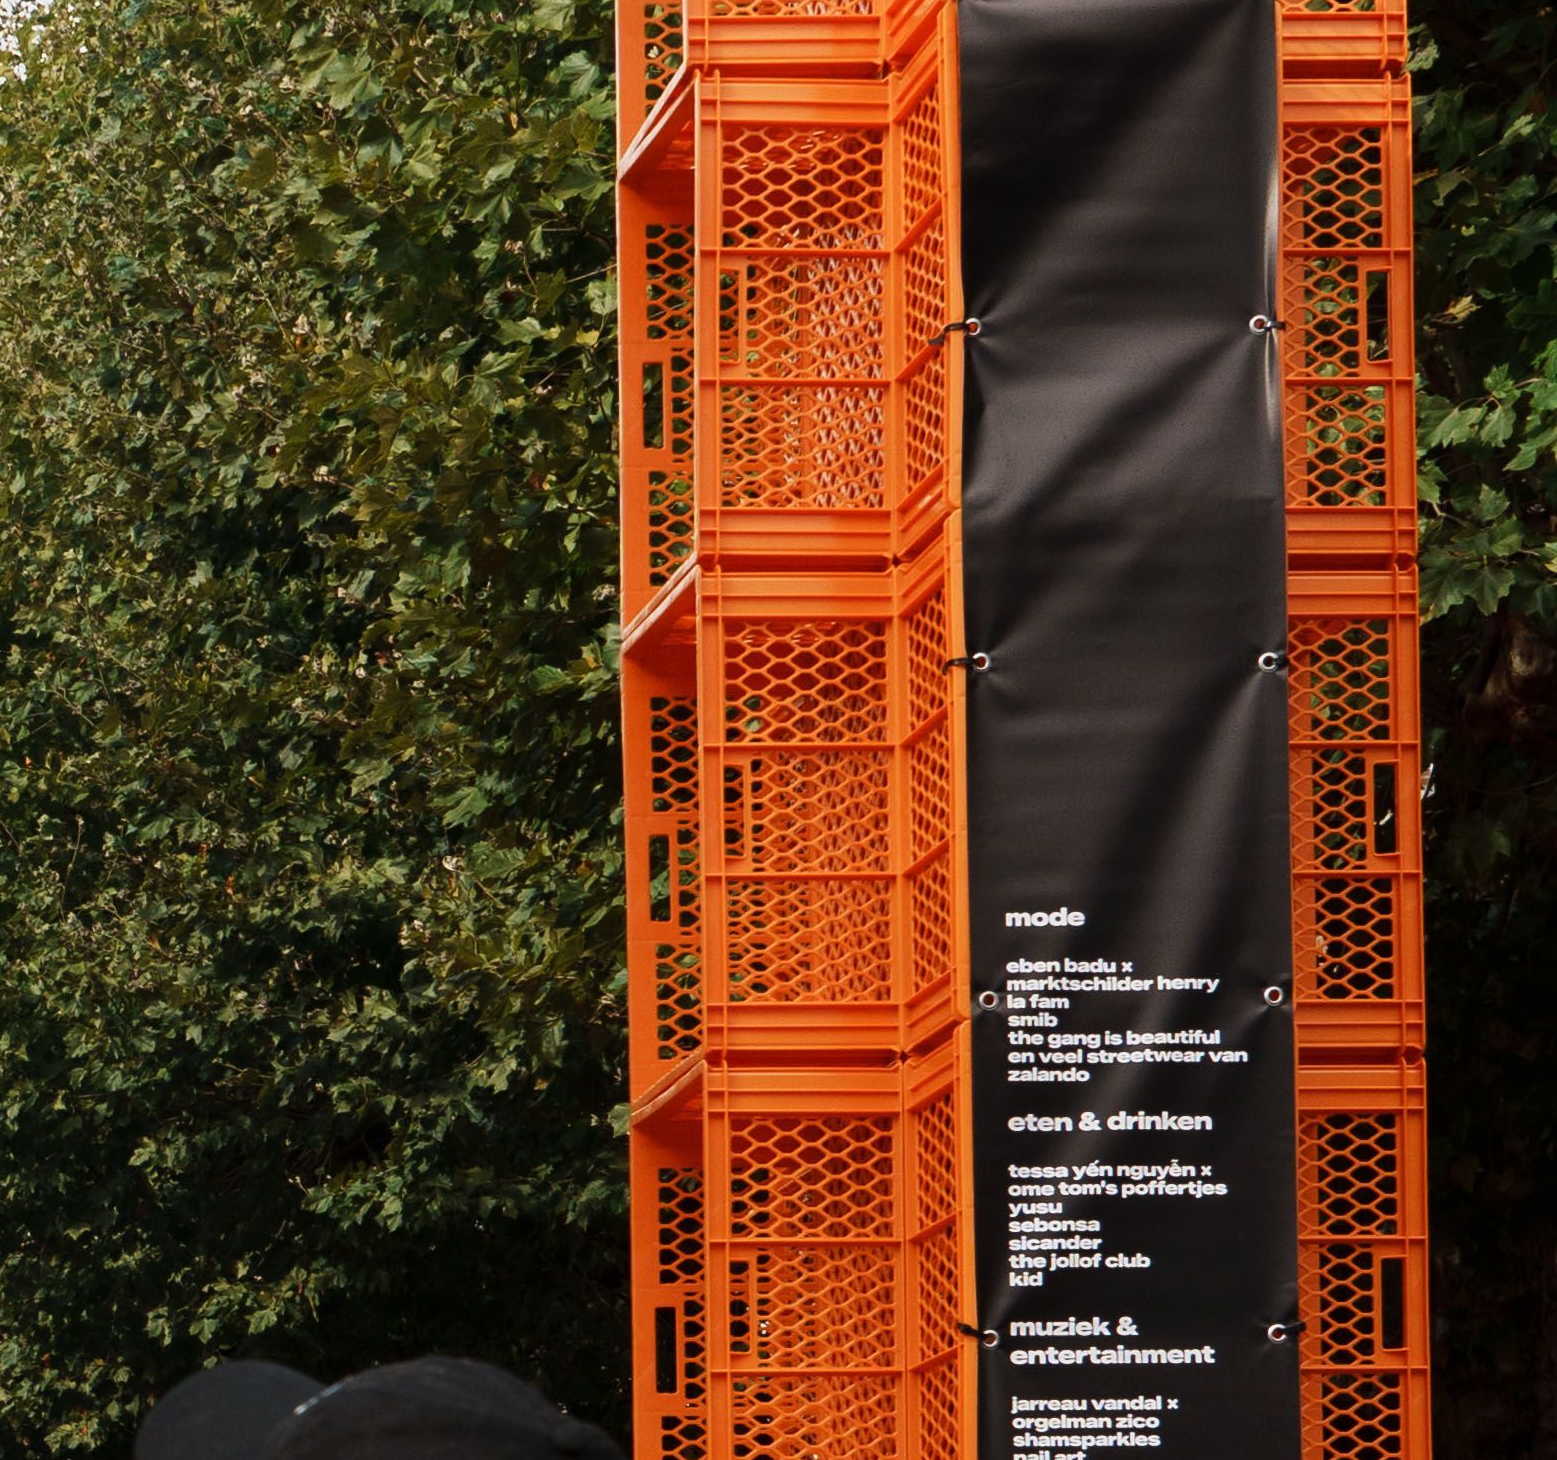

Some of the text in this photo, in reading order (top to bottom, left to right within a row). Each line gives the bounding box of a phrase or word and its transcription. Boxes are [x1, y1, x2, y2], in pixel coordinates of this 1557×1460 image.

[1005, 907, 1086, 927] mode
[1005, 958, 1133, 973] eben badu x
[1006, 975, 1220, 993] marktschilder henry
[1006, 994, 1070, 1009] la fam
[1007, 1012, 1059, 1027] smib
[1007, 1029, 1221, 1049] the gang is beautiful
[1007, 1048, 1249, 1064] en veel streetwear van
[1007, 1067, 1091, 1082] zalando
[1007, 1111, 1213, 1132] eten & drinken
[1007, 1163, 1069, 1178] tessa
[1200, 1165, 1212, 1177] x
[1007, 1184, 1056, 1197] ome
[1121, 1180, 1228, 1198] poffertjes
[1008, 1202, 1063, 1217] yusu
[1008, 1217, 1101, 1232] sebonsa
[1008, 1235, 1103, 1250] sicander
[1008, 1253, 1151, 1269] the jollof club
[1009, 1271, 1043, 1287] kid
[1010, 1316, 1139, 1336] muziek &
[1009, 1345, 1216, 1364] entertainment
[1011, 1395, 1179, 1414] jarreau vandal x
[1011, 1414, 1160, 1432] orgelman zico
[1012, 1432, 1162, 1450] shamsparkles
